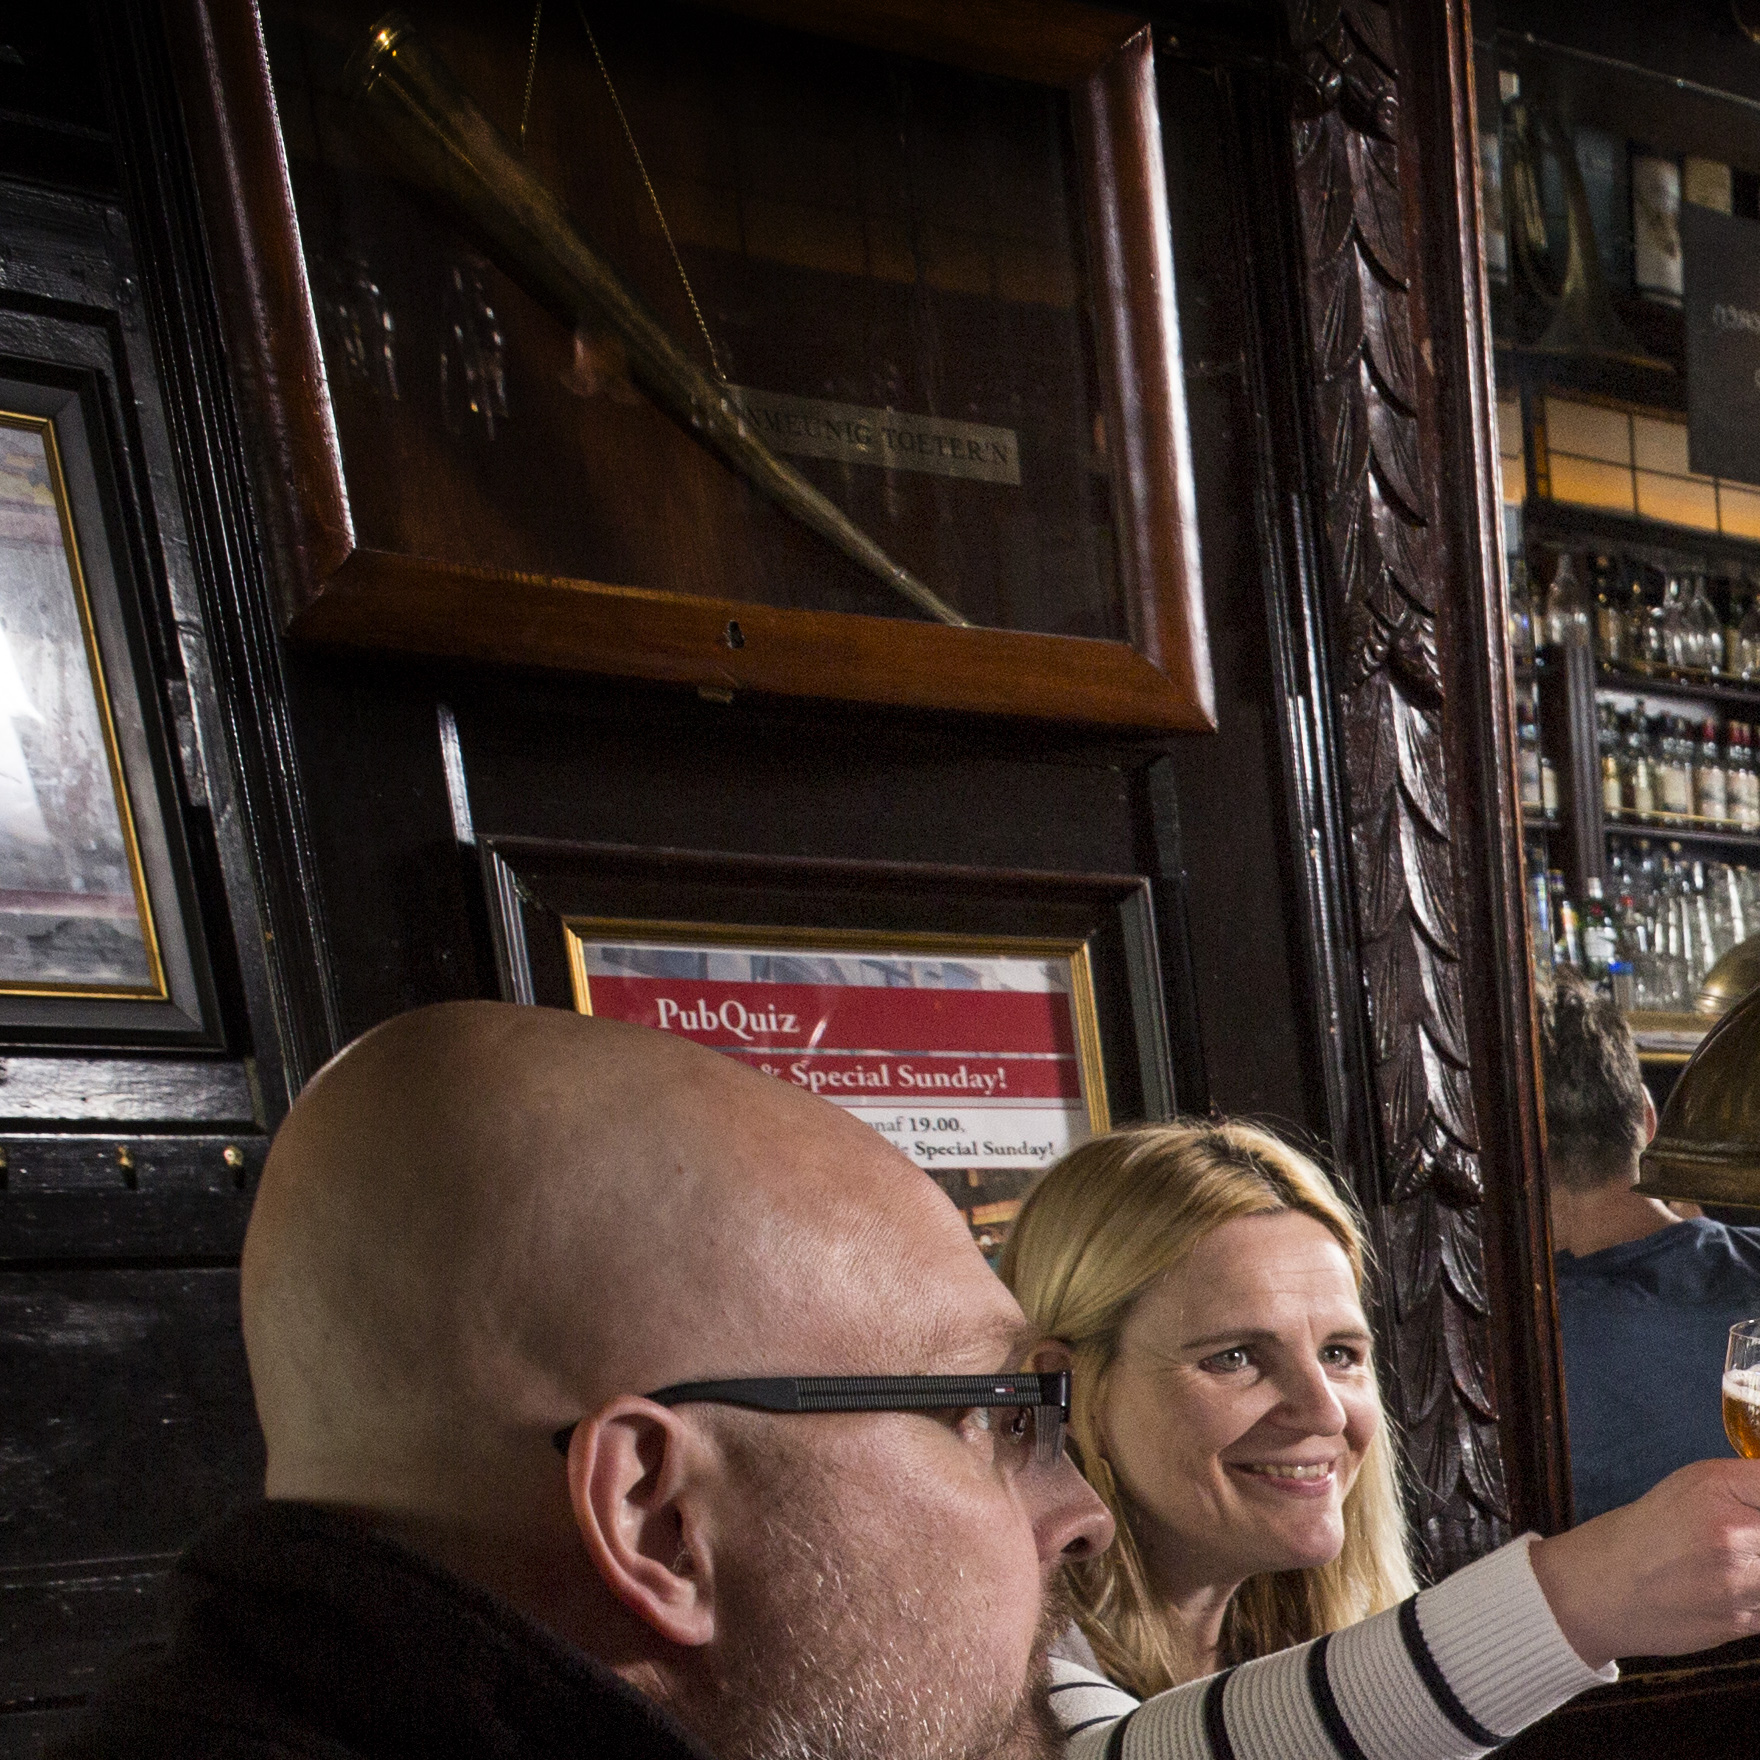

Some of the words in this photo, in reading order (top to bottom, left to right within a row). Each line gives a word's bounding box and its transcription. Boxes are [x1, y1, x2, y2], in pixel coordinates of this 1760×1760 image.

[654, 997, 800, 1041] PubQuiz
[790, 1063, 890, 1094] Special
[897, 1064, 1007, 1095] Sunday!
[914, 1141, 978, 1159] Special
[984, 1141, 1055, 1161] Sunday!
